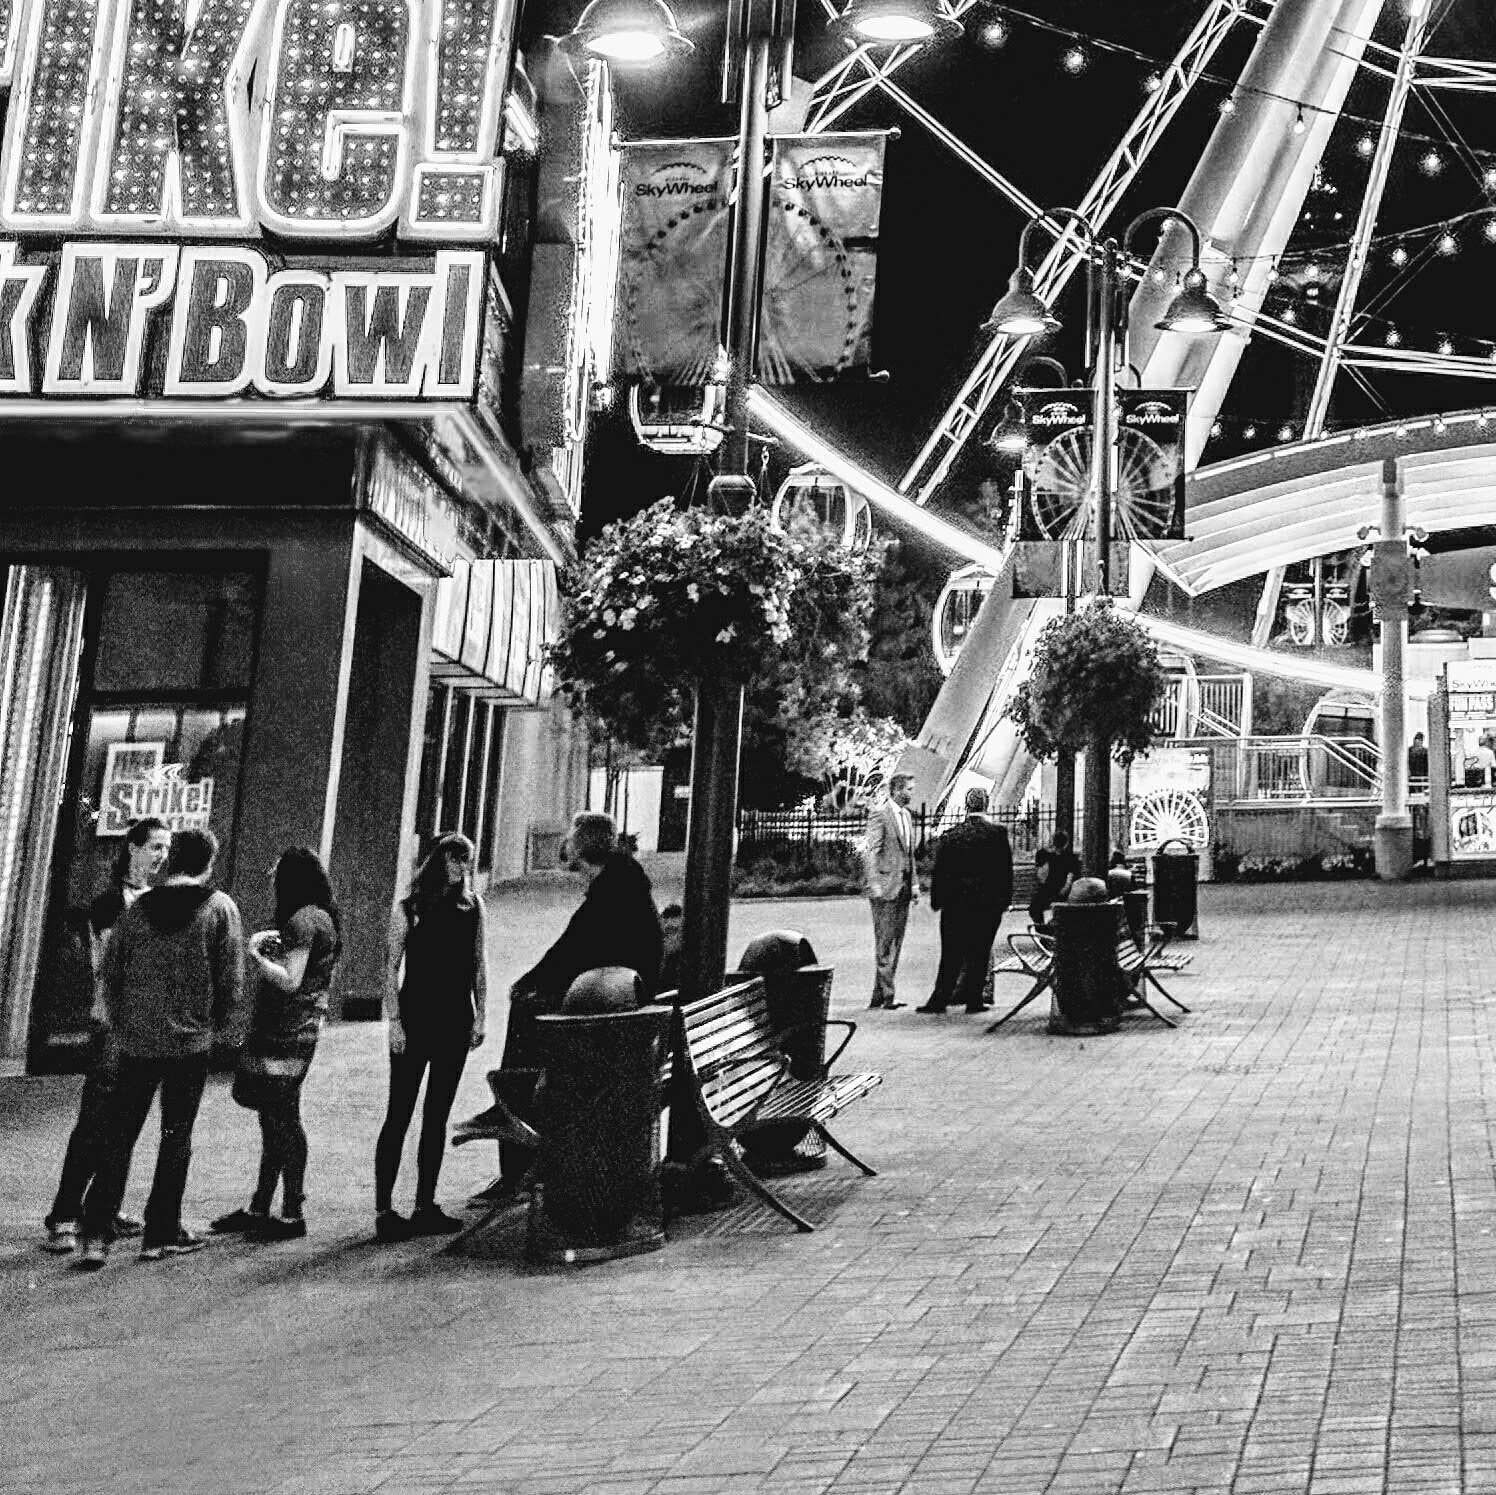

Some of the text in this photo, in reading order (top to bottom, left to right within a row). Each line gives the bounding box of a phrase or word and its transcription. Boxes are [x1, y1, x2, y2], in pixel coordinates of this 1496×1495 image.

[635, 181, 718, 198] SkyWheel
[783, 176, 868, 191] SkyWheel
[1032, 414, 1086, 426] SkyWheel
[1126, 414, 1180, 425] SkyWheel
[105, 778, 214, 832] Strike!
